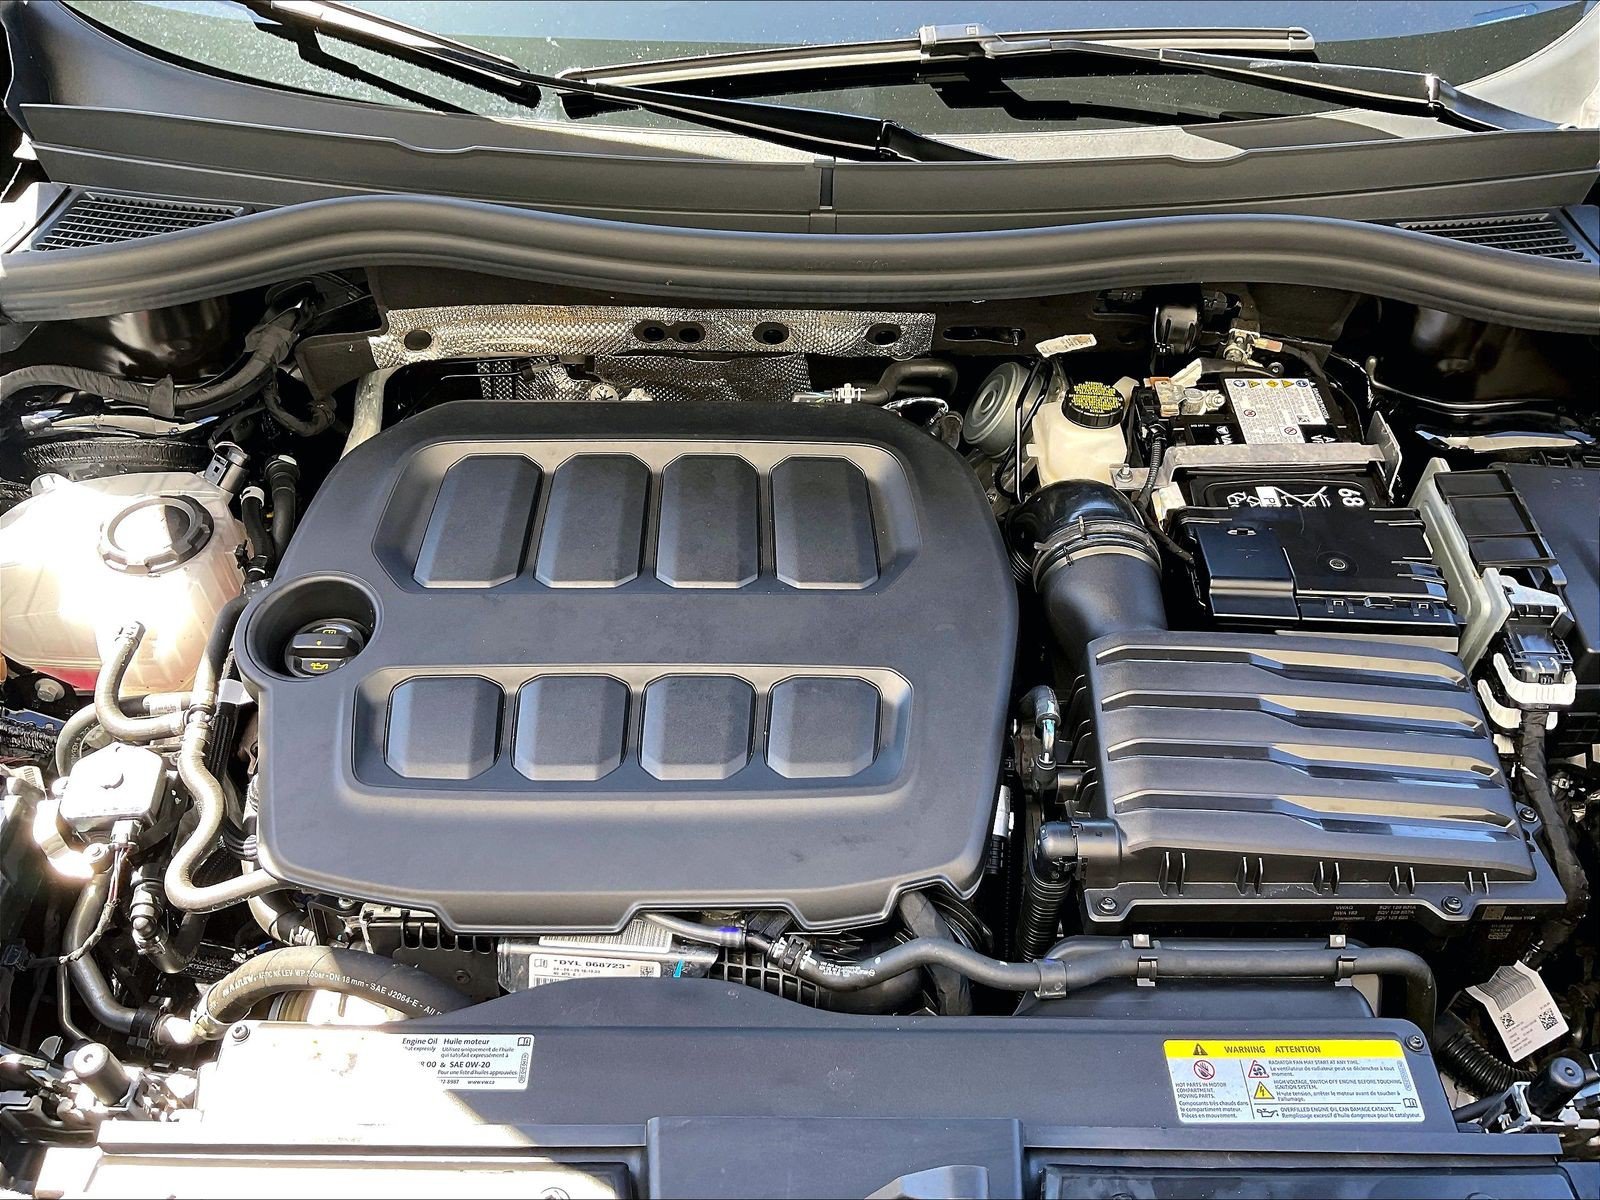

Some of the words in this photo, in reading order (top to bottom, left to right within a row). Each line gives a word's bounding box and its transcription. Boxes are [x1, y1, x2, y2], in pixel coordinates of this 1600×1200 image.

[1338, 488, 1365, 507] 68
[329, 971, 340, 981] DN
[342, 975, 350, 984] 18
[351, 978, 365, 987] mm
[370, 982, 387, 994] SAE
[387, 989, 419, 1007] J2064-E
[402, 1038, 426, 1046] Engine
